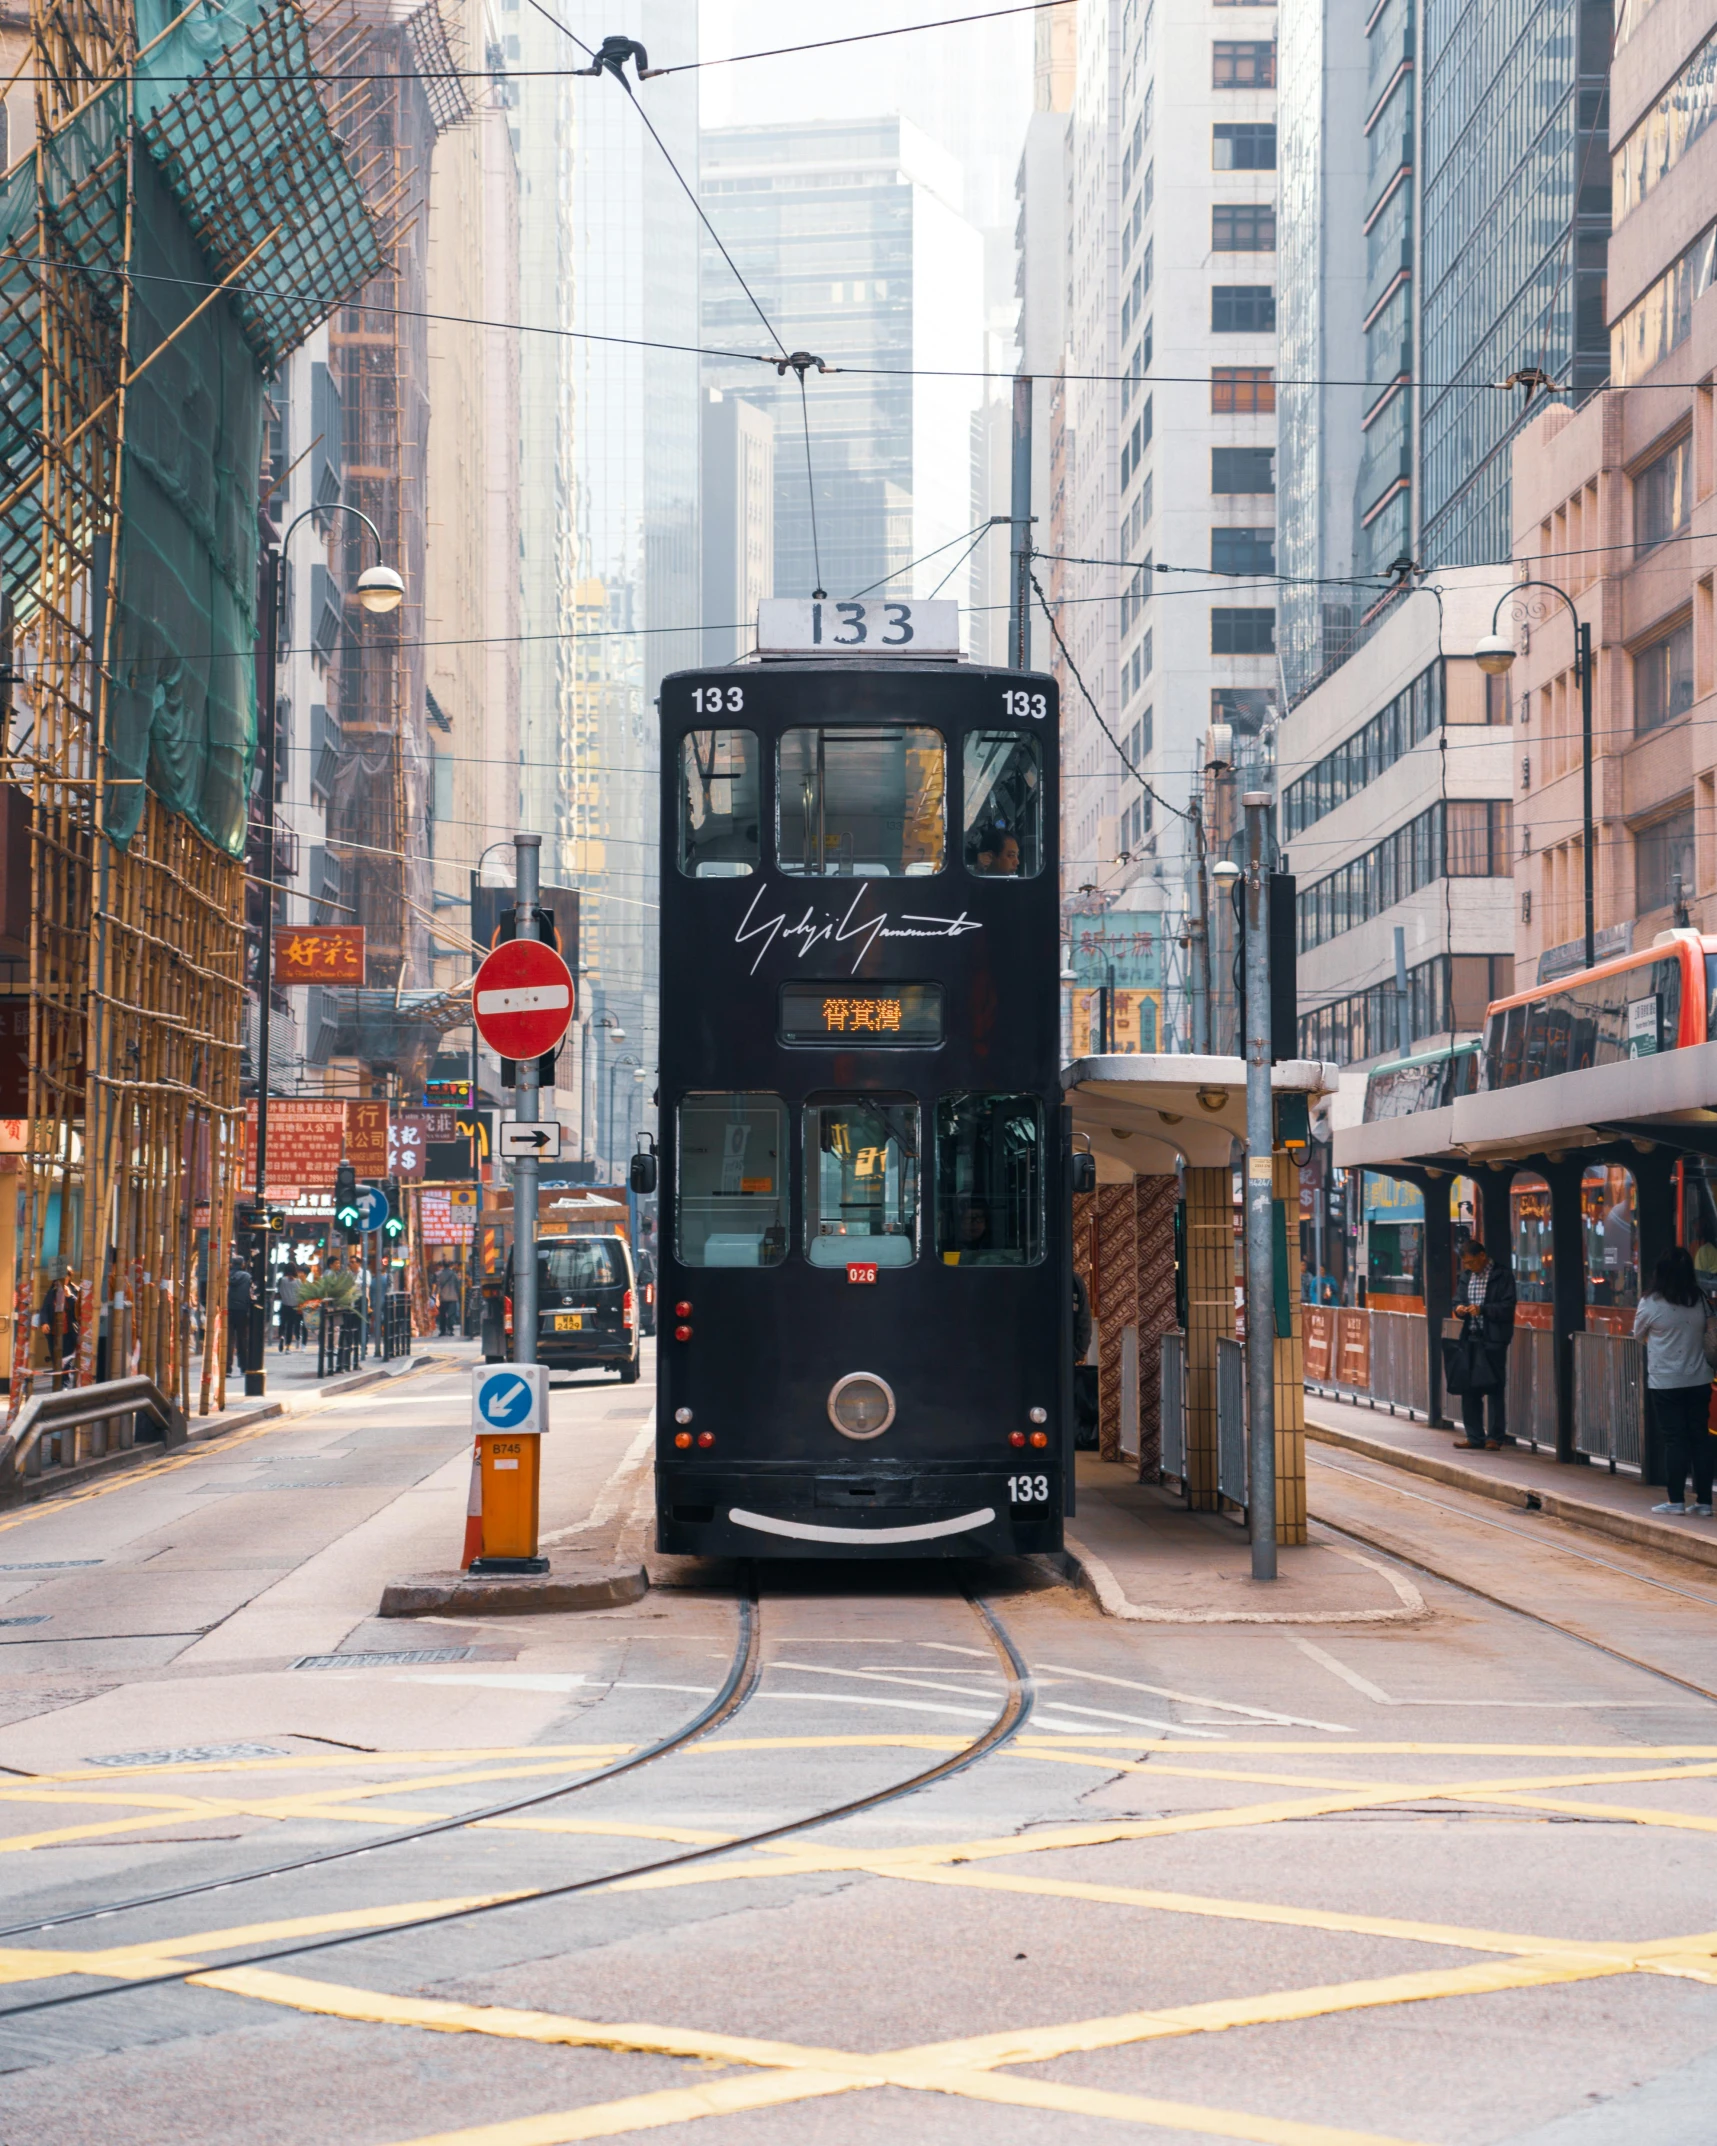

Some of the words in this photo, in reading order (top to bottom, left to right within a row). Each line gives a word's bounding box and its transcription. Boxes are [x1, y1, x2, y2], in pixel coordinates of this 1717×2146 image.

[813, 602, 914, 645] 133
[691, 686, 744, 713] 133
[1002, 690, 1047, 719] 133
[822, 999, 902, 1031] 筲箕灣
[250, 1102, 341, 1114] 永外幣找換有限公司
[401, 1150, 417, 1170] $
[271, 1216, 283, 1231] €
[848, 1268, 875, 1283] 026
[557, 1322, 580, 1331] 2429
[493, 1444, 521, 1454] B745
[1007, 1474, 1049, 1502] 133
